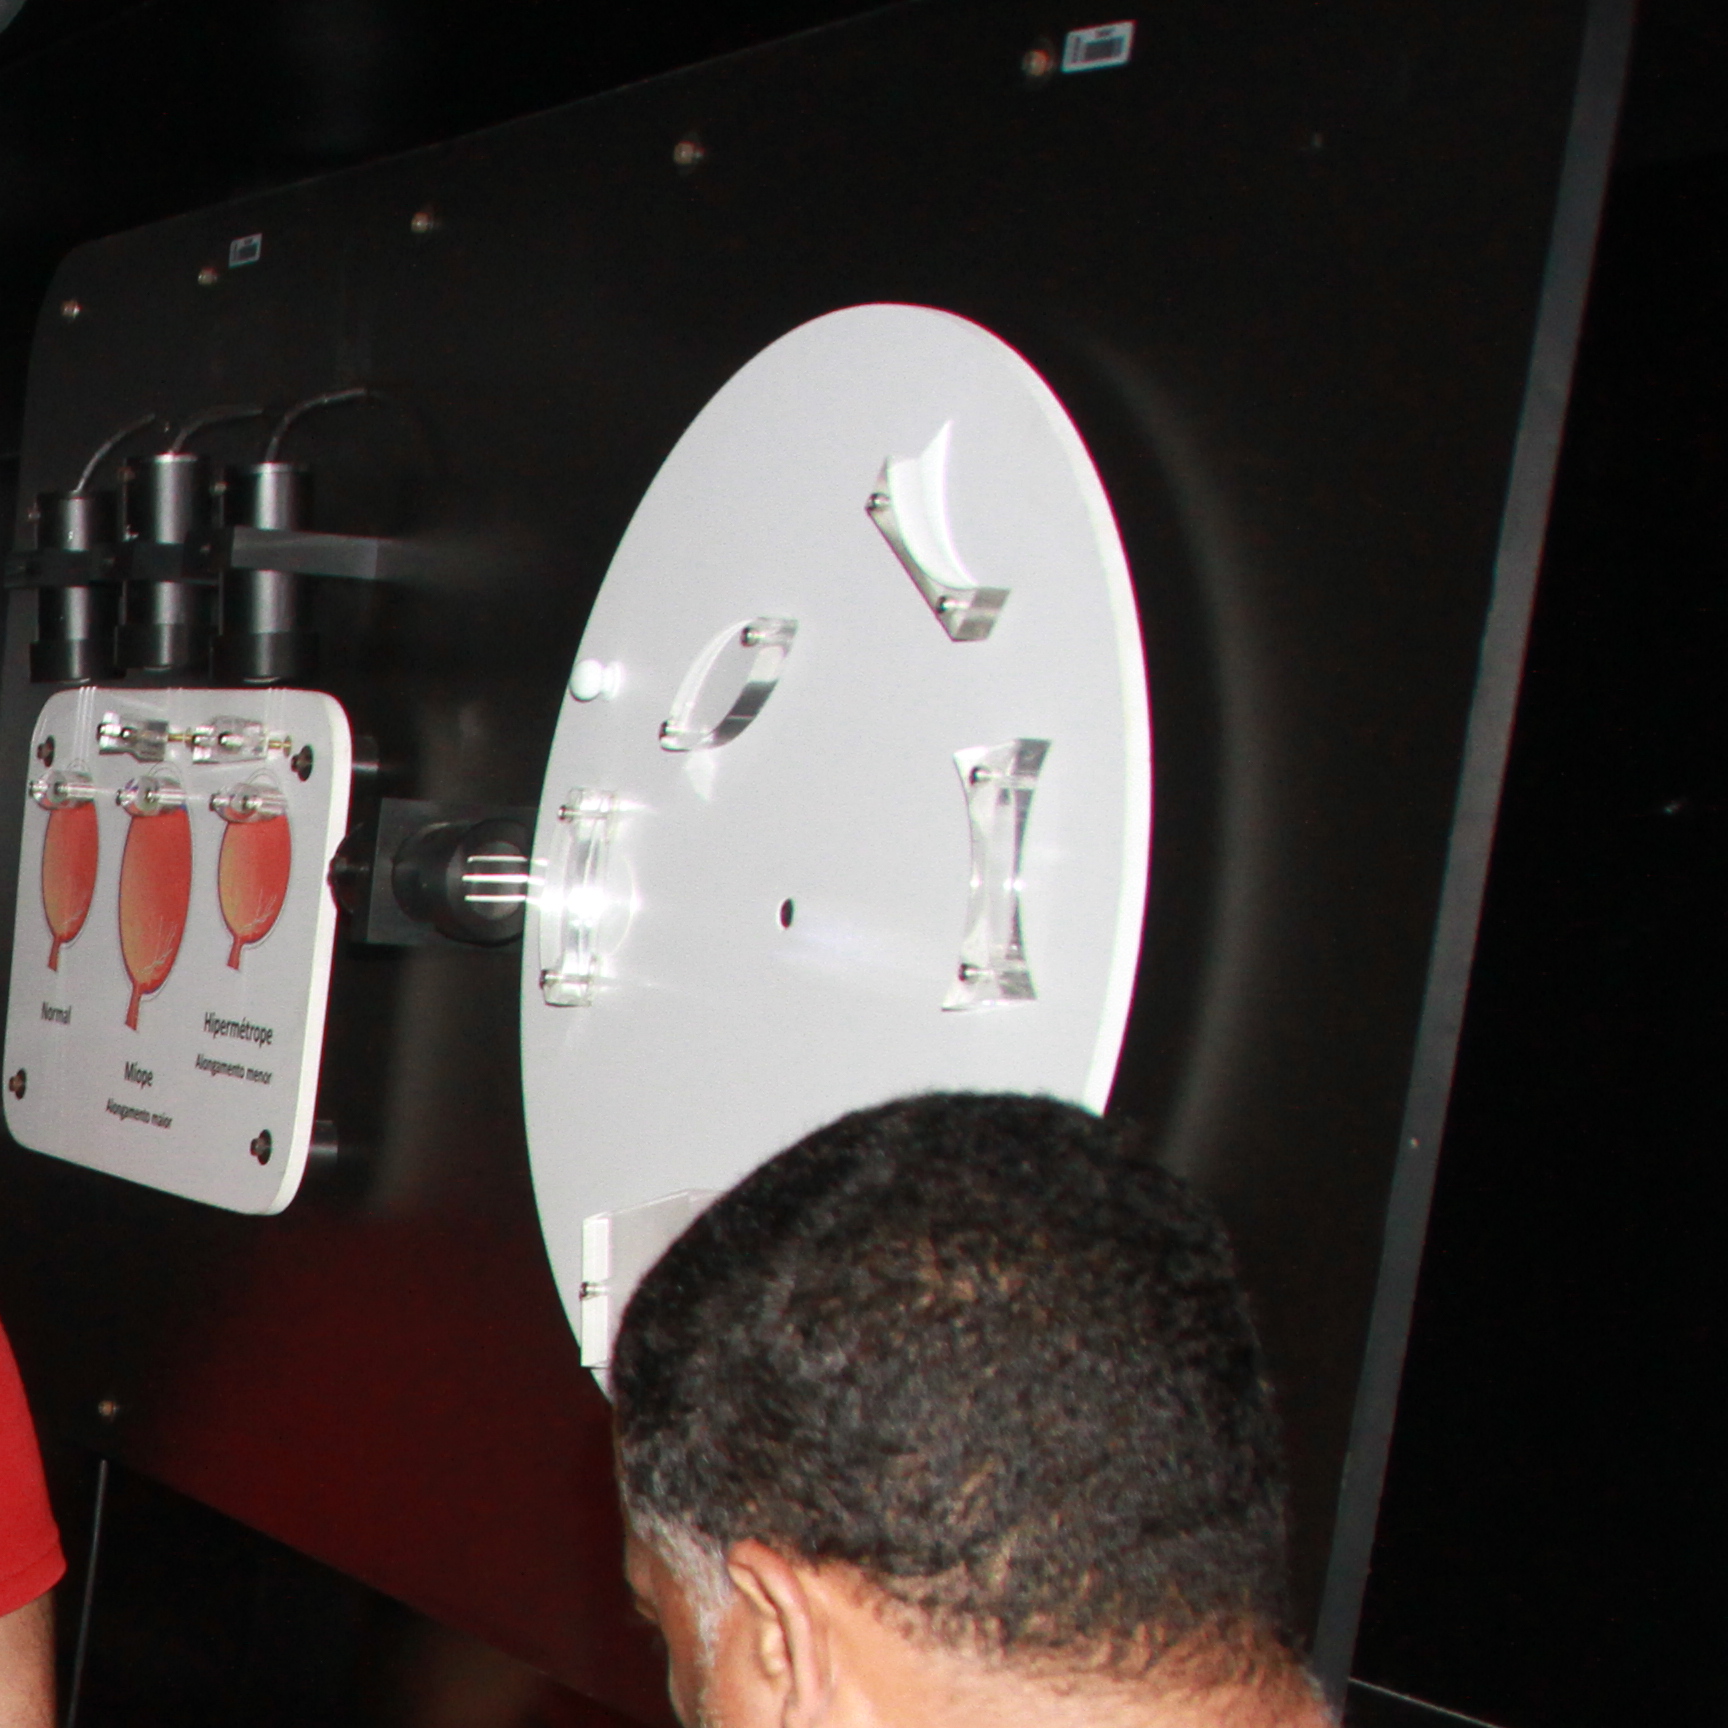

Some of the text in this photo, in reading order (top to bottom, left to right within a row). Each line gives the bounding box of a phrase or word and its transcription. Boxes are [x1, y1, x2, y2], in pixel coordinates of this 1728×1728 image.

[40, 1001, 72, 1025] Normal
[203, 1012, 273, 1048] Hipermétrope
[195, 1054, 273, 1085] Alongamento menor
[106, 1098, 172, 1129] Alongamento maior
